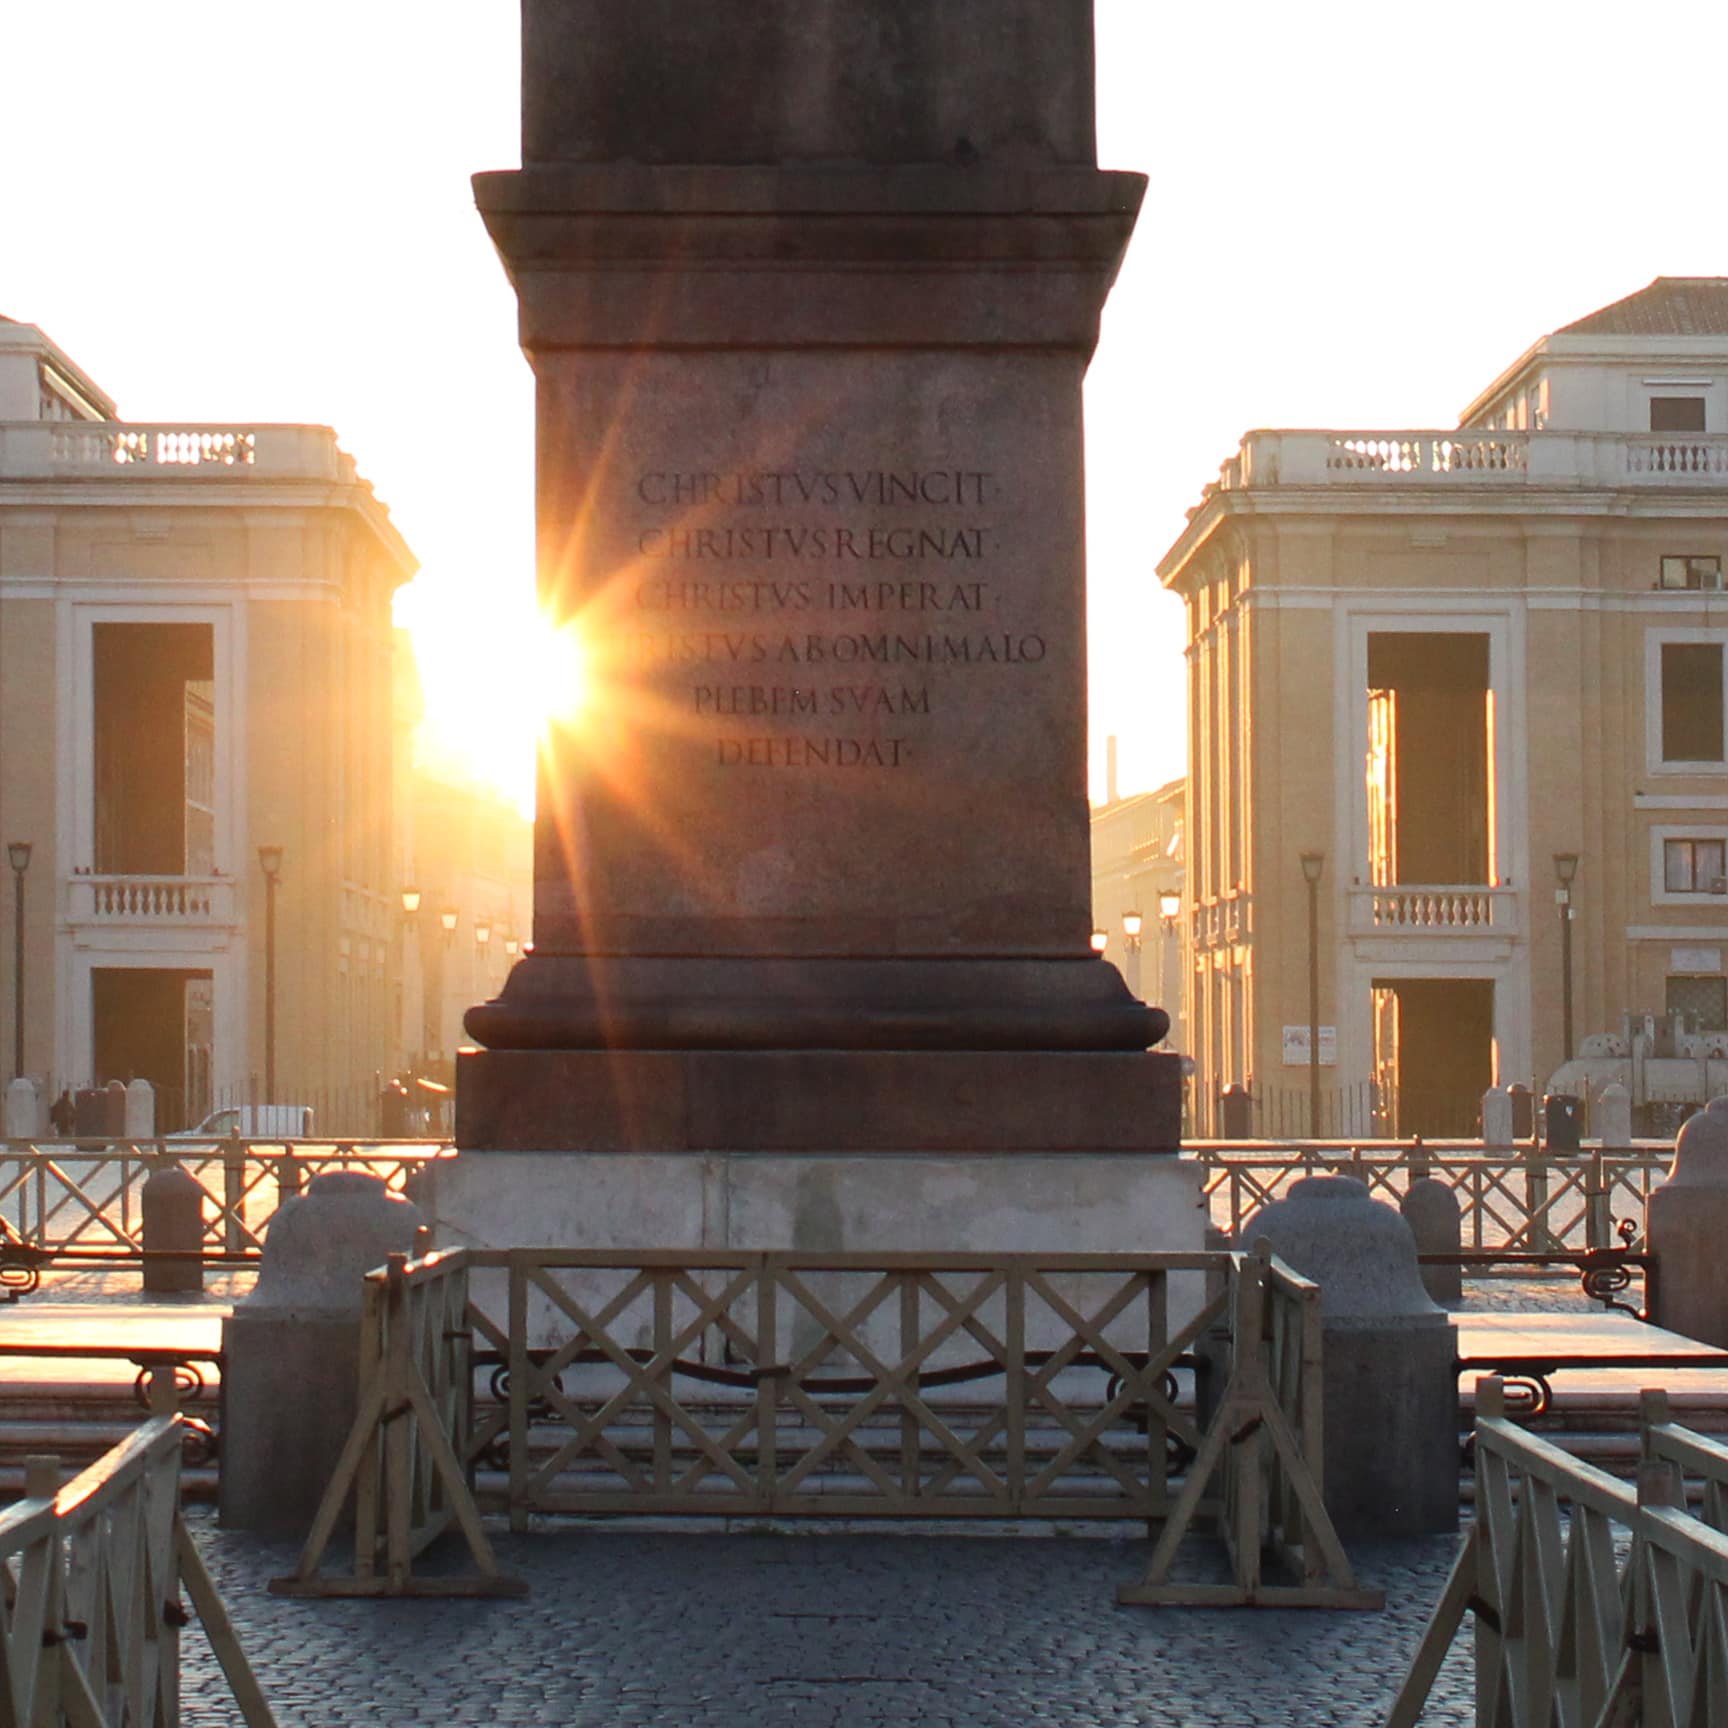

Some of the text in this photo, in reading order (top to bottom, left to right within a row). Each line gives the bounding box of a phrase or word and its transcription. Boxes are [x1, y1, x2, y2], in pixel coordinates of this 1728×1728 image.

[636, 471, 840, 507] CHRISTVS
[637, 527, 829, 560] CHRISTVS
[633, 581, 811, 612] CHRISTVS
[776, 633, 825, 664] AB
[831, 633, 939, 664] OMNI
[940, 633, 1048, 665] MALO
[692, 684, 933, 715] PLEBEM SVAM
